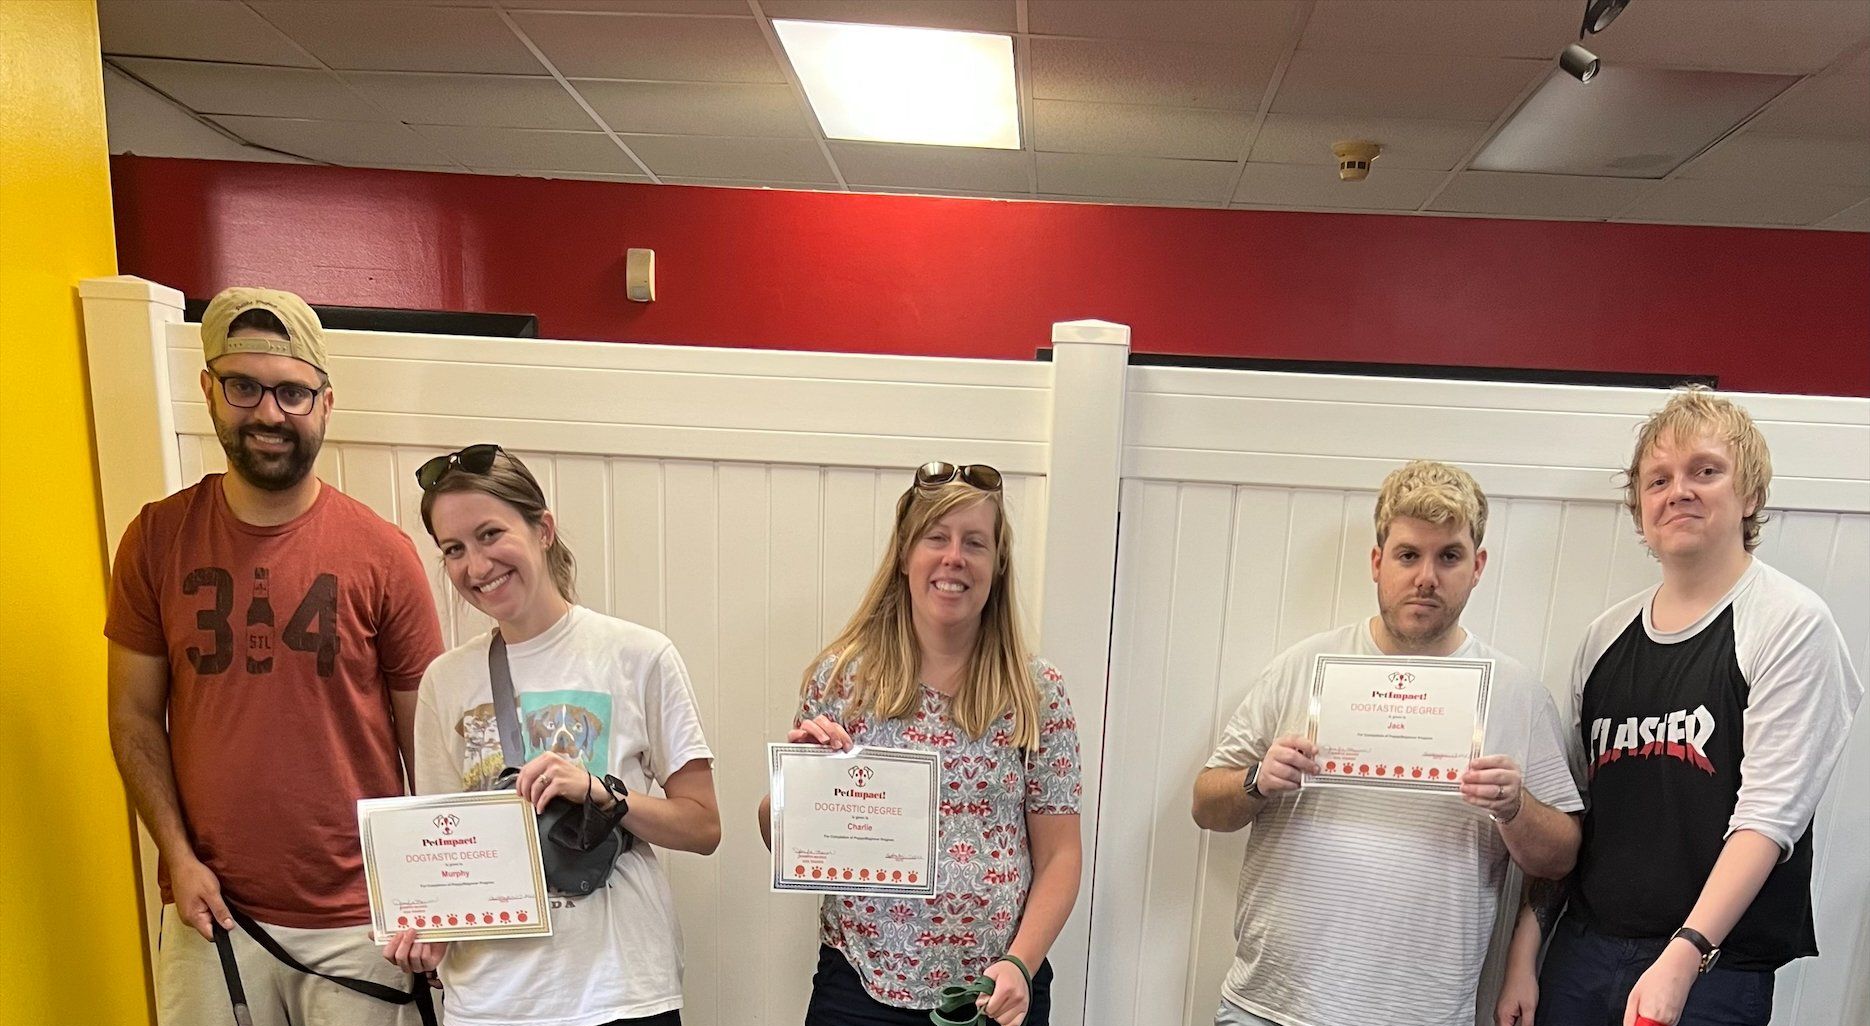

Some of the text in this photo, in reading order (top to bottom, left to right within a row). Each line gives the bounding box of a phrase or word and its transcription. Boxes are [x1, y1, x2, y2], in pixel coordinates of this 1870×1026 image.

[248, 634, 272, 650] STL
[1371, 691, 1427, 701] PetImpact!
[1350, 703, 1446, 716] DOGTASTIC DEGREE
[1387, 721, 1406, 731] Jack
[834, 788, 886, 800] PetImpact!
[815, 802, 903, 817] DOGTASTIC DEGREE
[847, 822, 873, 832] Charlie
[422, 836, 478, 848] PetImpact!
[405, 849, 499, 864] DOGTASTIC DEGREE
[441, 869, 470, 879] Murphy
